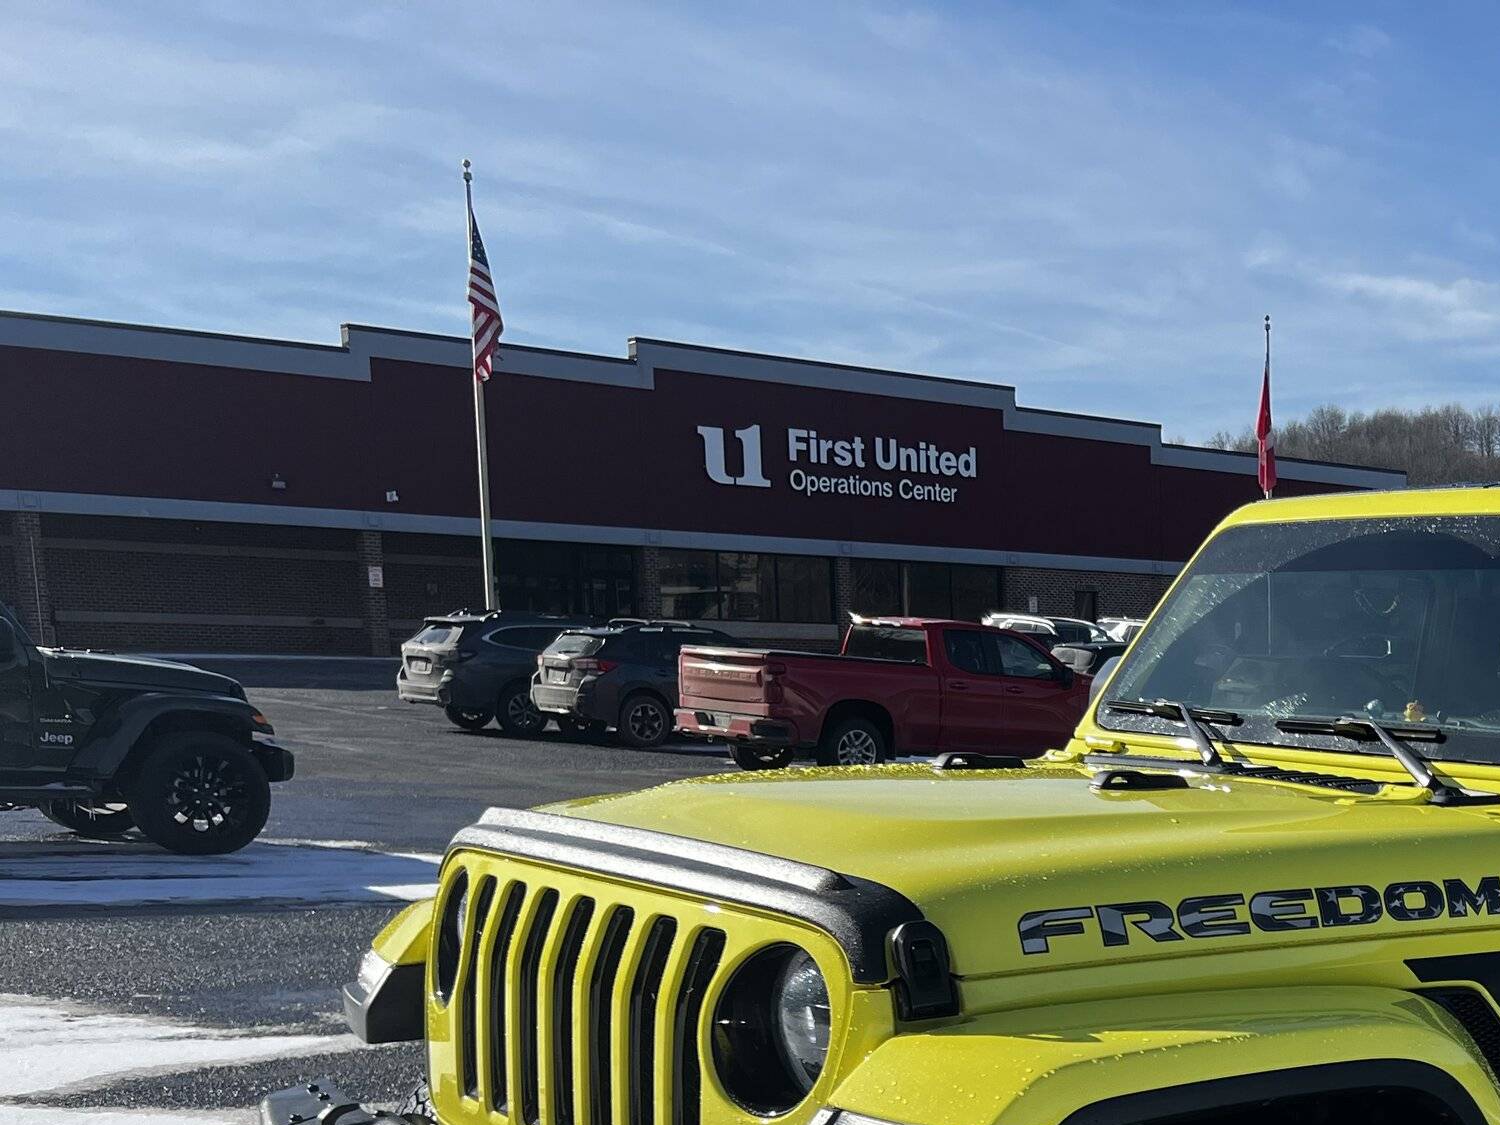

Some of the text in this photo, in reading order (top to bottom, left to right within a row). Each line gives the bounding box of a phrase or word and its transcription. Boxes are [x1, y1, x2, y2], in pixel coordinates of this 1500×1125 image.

[788, 427, 977, 478] First United
[789, 469, 957, 503] Operations Center
[40, 731, 73, 745] Jeep
